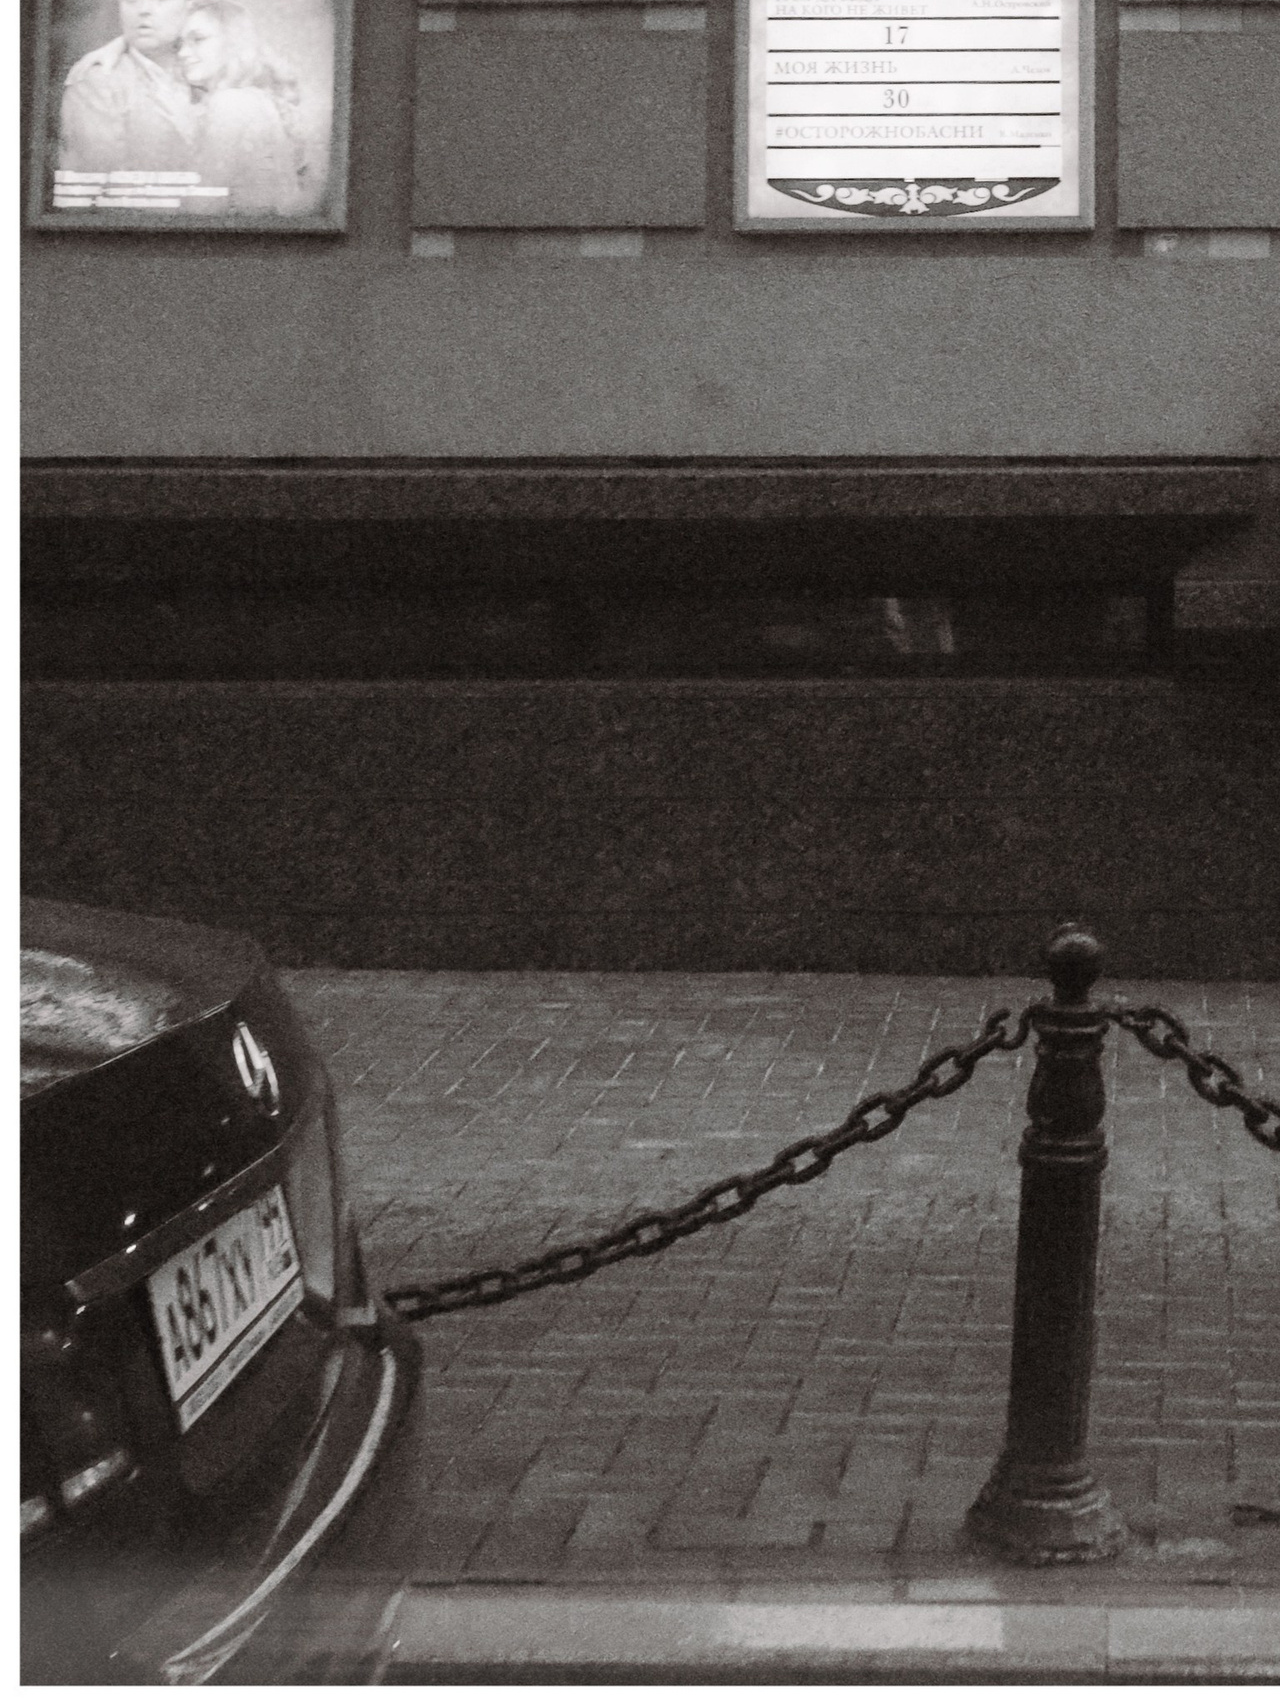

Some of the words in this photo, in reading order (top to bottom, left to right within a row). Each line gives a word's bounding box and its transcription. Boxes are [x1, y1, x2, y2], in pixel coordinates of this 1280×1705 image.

[886, 26, 909, 45] 17
[774, 61, 817, 75] МОЯ
[825, 61, 897, 74] ЖИЗНЬ
[883, 89, 910, 109] 30
[774, 125, 984, 141] #ОСТОРОЖНОБАСНИ
